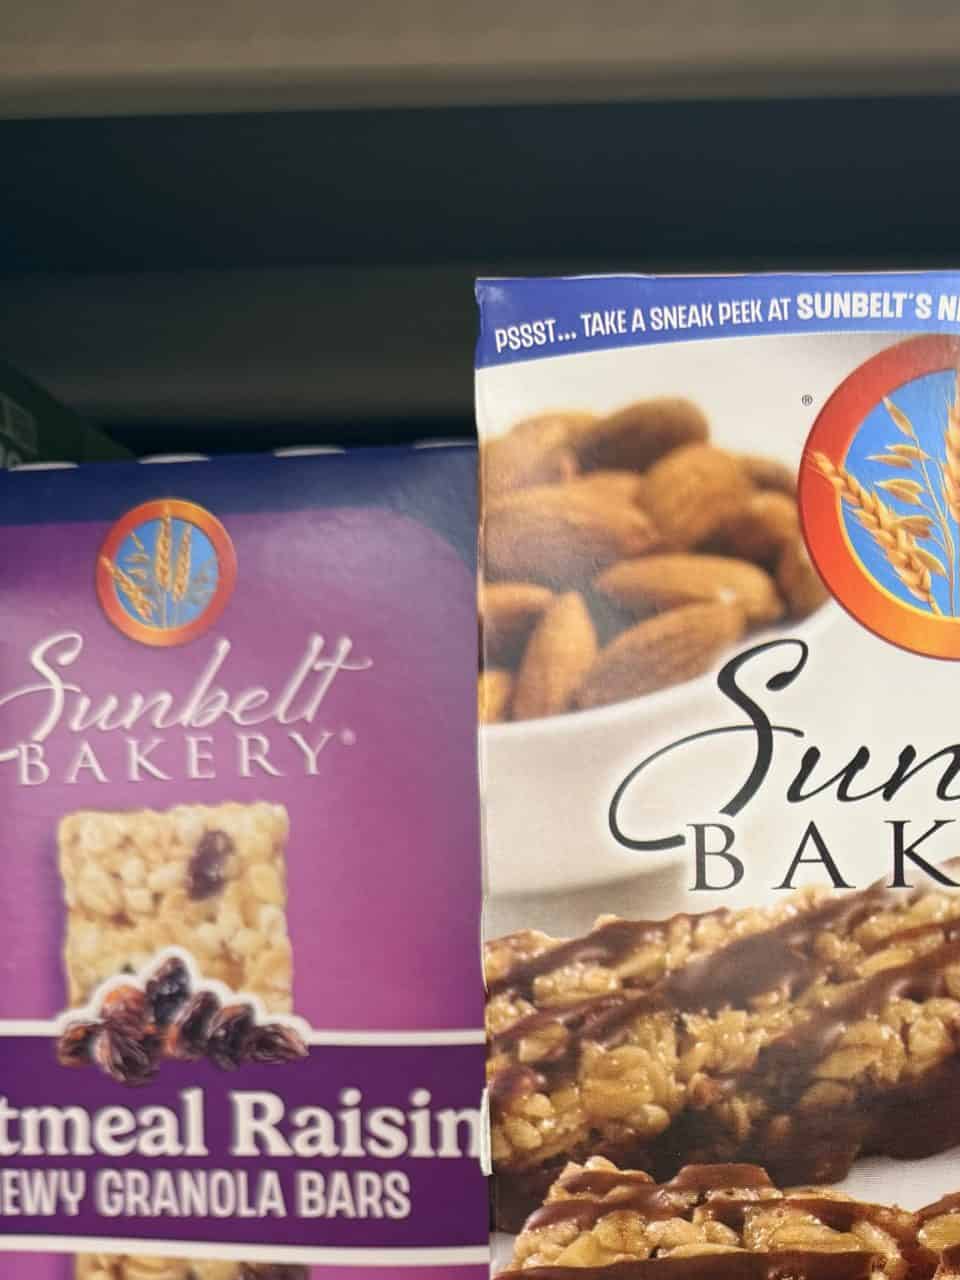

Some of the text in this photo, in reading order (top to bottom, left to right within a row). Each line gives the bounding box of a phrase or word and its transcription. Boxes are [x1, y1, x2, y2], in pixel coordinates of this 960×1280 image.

[495, 319, 577, 352] PSSST...
[581, 309, 627, 337] TAKE
[631, 307, 646, 332] A
[650, 303, 714, 331] SNEAK
[718, 298, 762, 325] PEEK
[767, 296, 791, 321] AT
[797, 292, 933, 320] SUNBELT'S
[0, 630, 374, 763] Sunbelt
[17, 730, 335, 786] BAKERY
[230, 1088, 483, 1158] Raisin
[98, 1168, 288, 1218] GRANOLA
[295, 1170, 413, 1220] BARS
